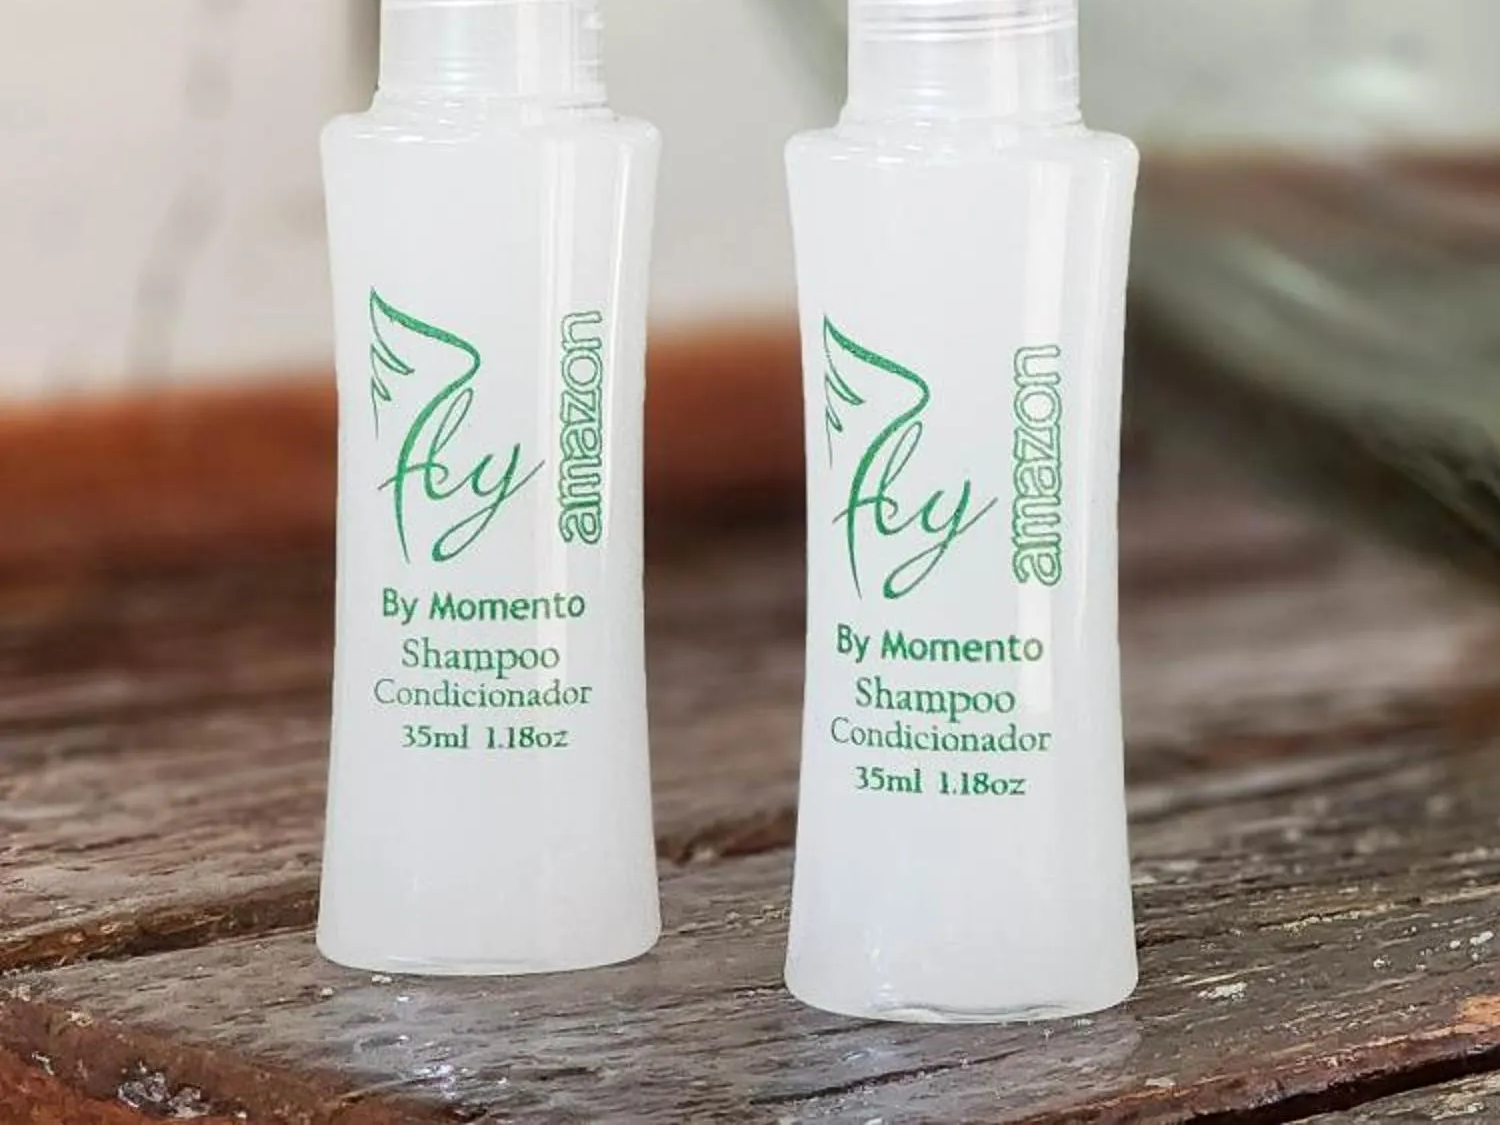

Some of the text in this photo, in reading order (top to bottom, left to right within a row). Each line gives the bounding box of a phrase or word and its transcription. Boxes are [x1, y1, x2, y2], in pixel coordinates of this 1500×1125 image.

[558, 310, 602, 545] amazon
[1012, 344, 1061, 587] amazon
[383, 588, 585, 625] By Momento
[402, 638, 560, 678] Shampoo
[837, 624, 1043, 664] By Momento
[373, 679, 592, 708] Condicionador
[855, 677, 1015, 722] Shampoo
[402, 725, 568, 749] 35ml 1.18oz
[831, 718, 1052, 753] Condicionador
[855, 767, 1026, 796] 35ml 1.18oz
